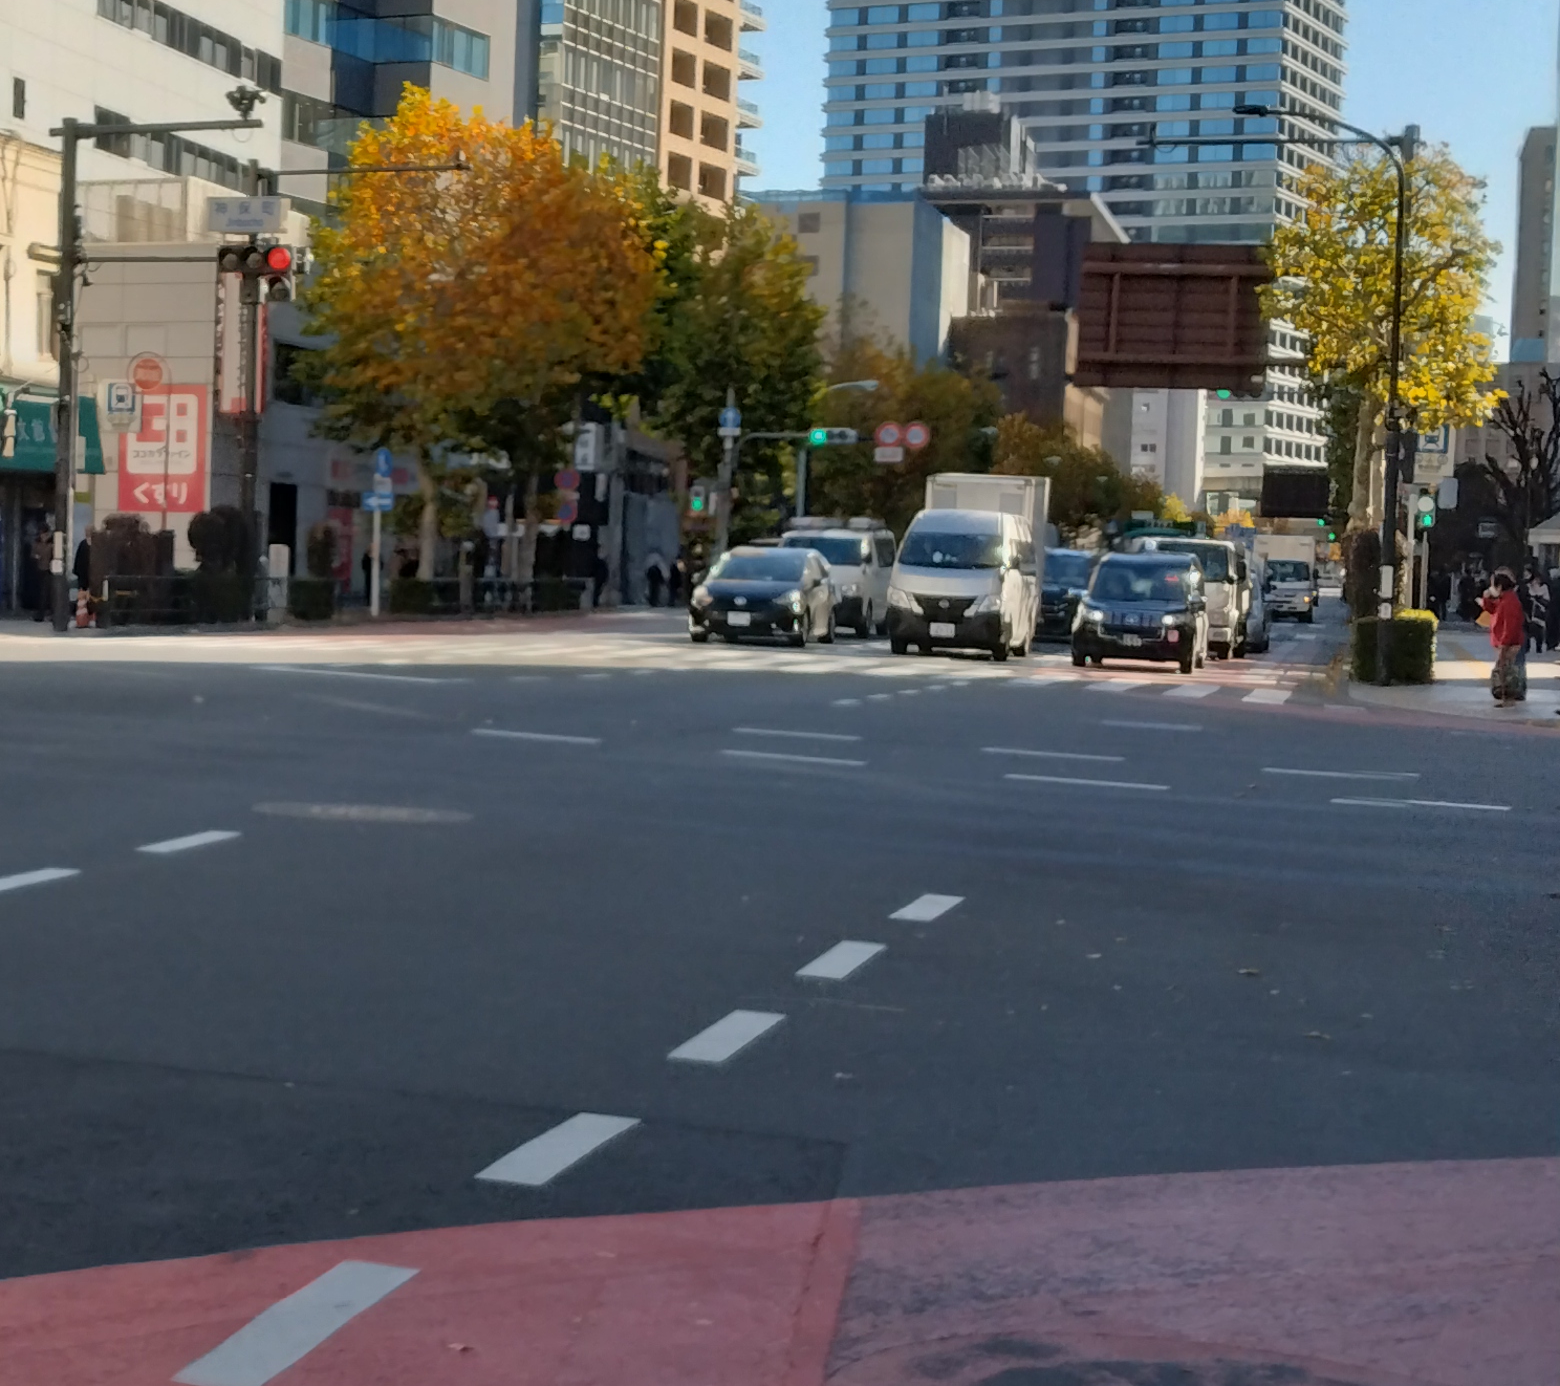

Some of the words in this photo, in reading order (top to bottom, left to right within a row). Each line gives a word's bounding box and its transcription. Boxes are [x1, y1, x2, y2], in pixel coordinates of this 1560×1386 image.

[133, 445, 192, 459] ココカラァイン
[133, 481, 189, 509] くすり
